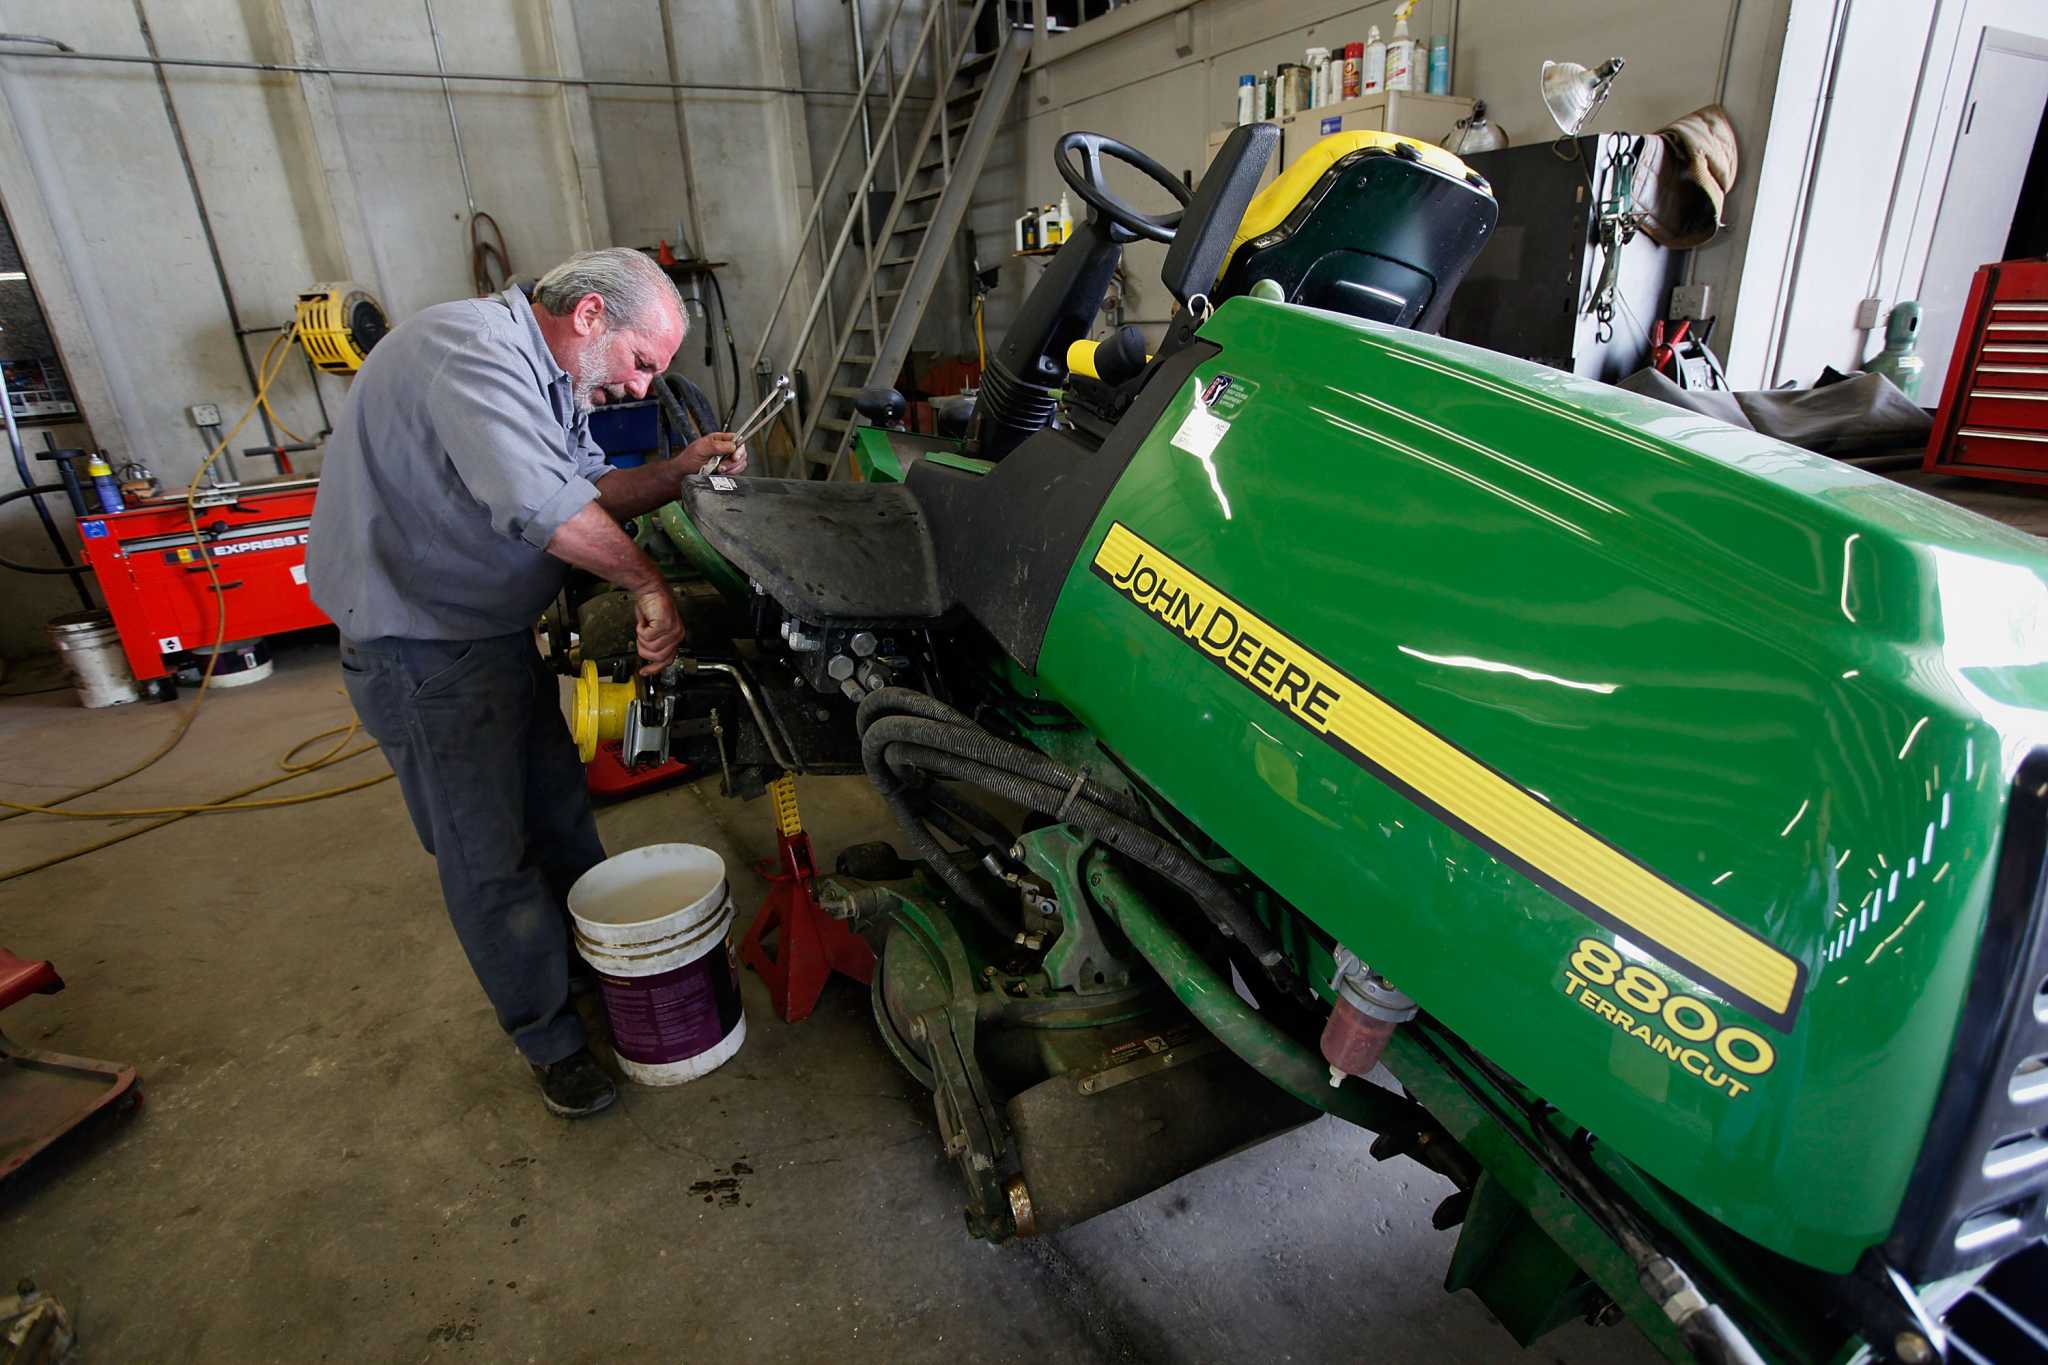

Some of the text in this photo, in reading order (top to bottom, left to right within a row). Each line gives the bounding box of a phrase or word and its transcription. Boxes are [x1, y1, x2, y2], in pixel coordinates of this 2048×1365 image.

[214, 536, 297, 556] EXPRESS
[1114, 554, 1341, 726] JOHN DEERE
[1563, 971, 1750, 1099] TERRAINCUT
[1569, 938, 1775, 1076] 8800
